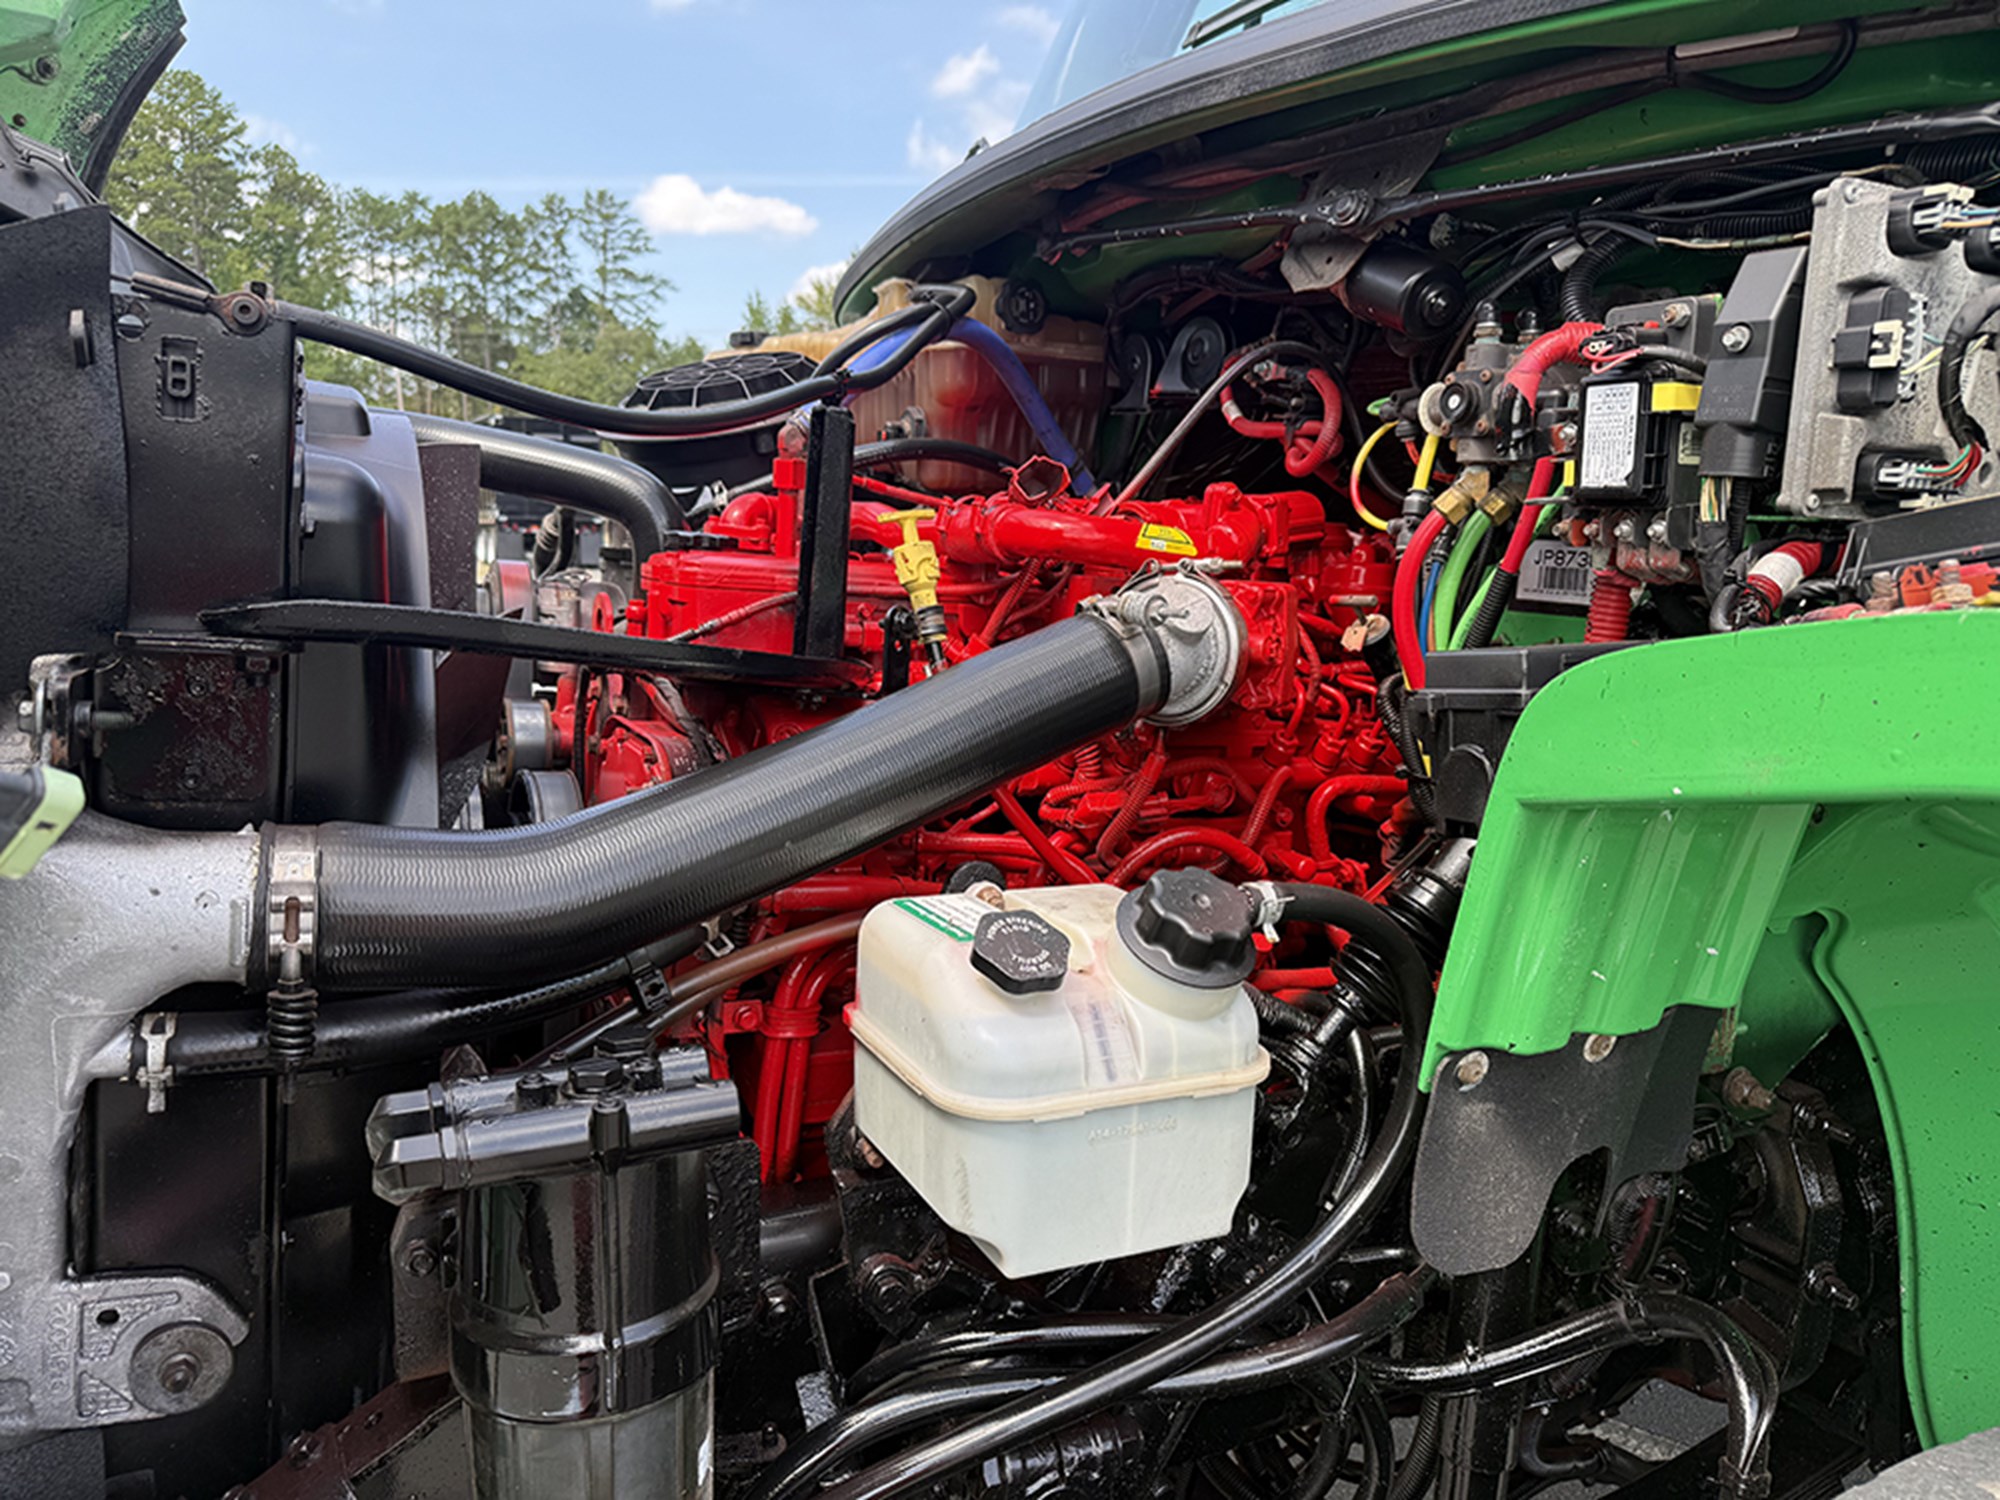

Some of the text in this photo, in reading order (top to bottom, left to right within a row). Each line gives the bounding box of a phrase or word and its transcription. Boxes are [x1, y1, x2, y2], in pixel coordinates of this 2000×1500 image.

[1534, 549, 1592, 568] JP873
[986, 918, 1006, 941] POWER
[1005, 916, 1049, 935] STEERING
[1001, 924, 1031, 935] FLUID
